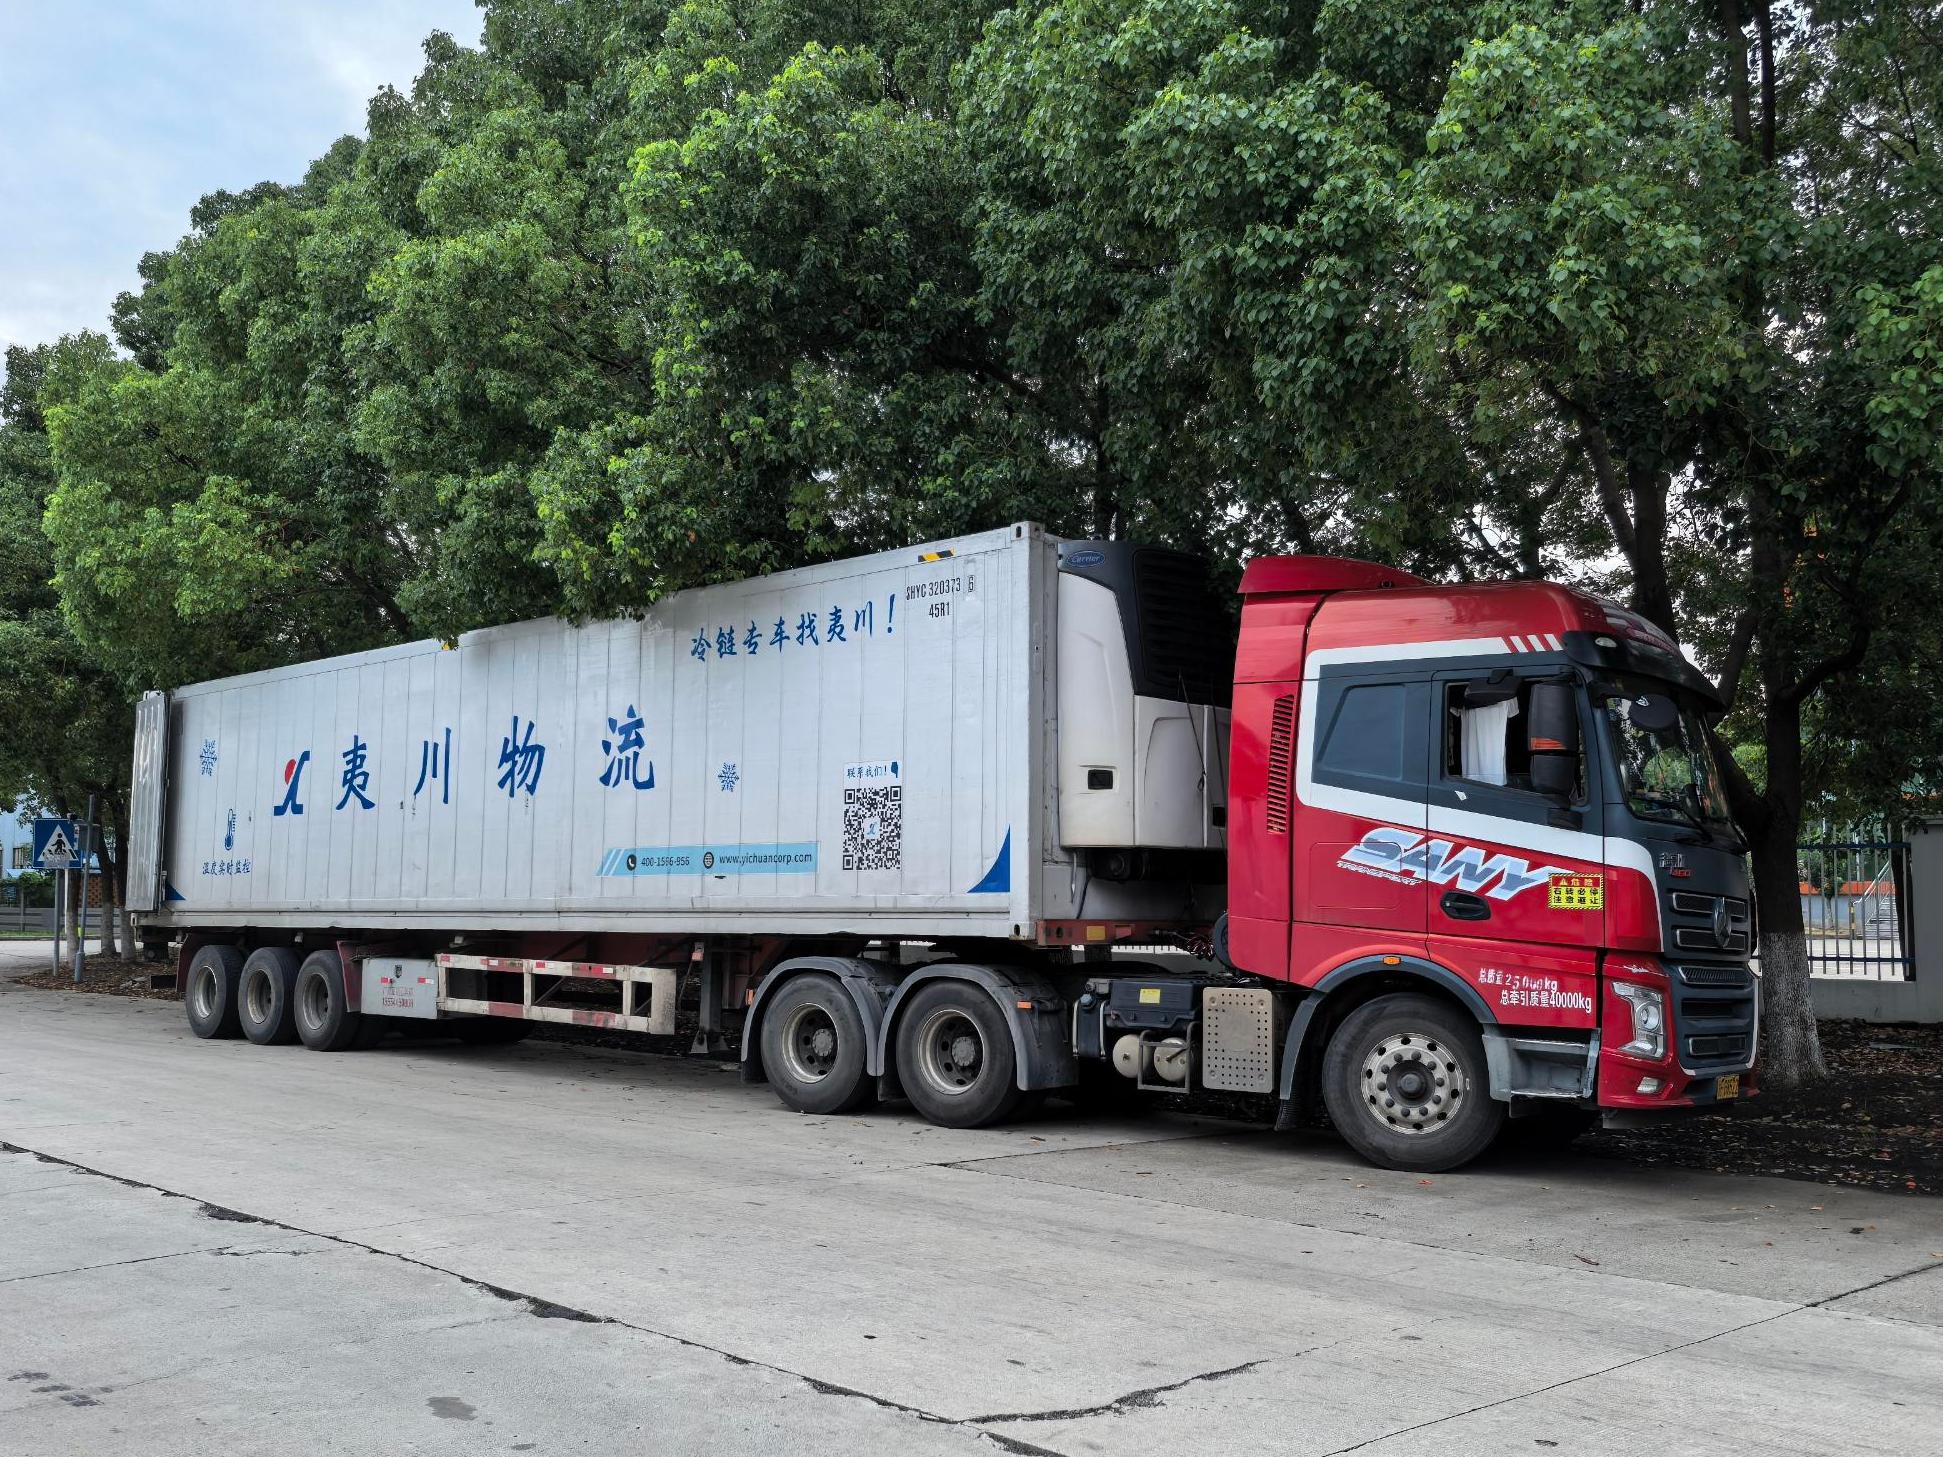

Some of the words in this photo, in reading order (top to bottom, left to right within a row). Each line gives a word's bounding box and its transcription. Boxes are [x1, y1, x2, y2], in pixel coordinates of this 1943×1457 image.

[906, 583, 927, 601] SHYC
[928, 577, 961, 597] 320373
[968, 576, 975, 592] 6
[929, 602, 950, 618] 45R1
[690, 593, 896, 662] 冷链专车找夷川！
[335, 703, 655, 811] 夷川物流
[719, 852, 813, 866] www.yichuancorp.com
[1340, 826, 1575, 901] SANY
[1500, 989, 1592, 1014] 总牵引质量40000kg
